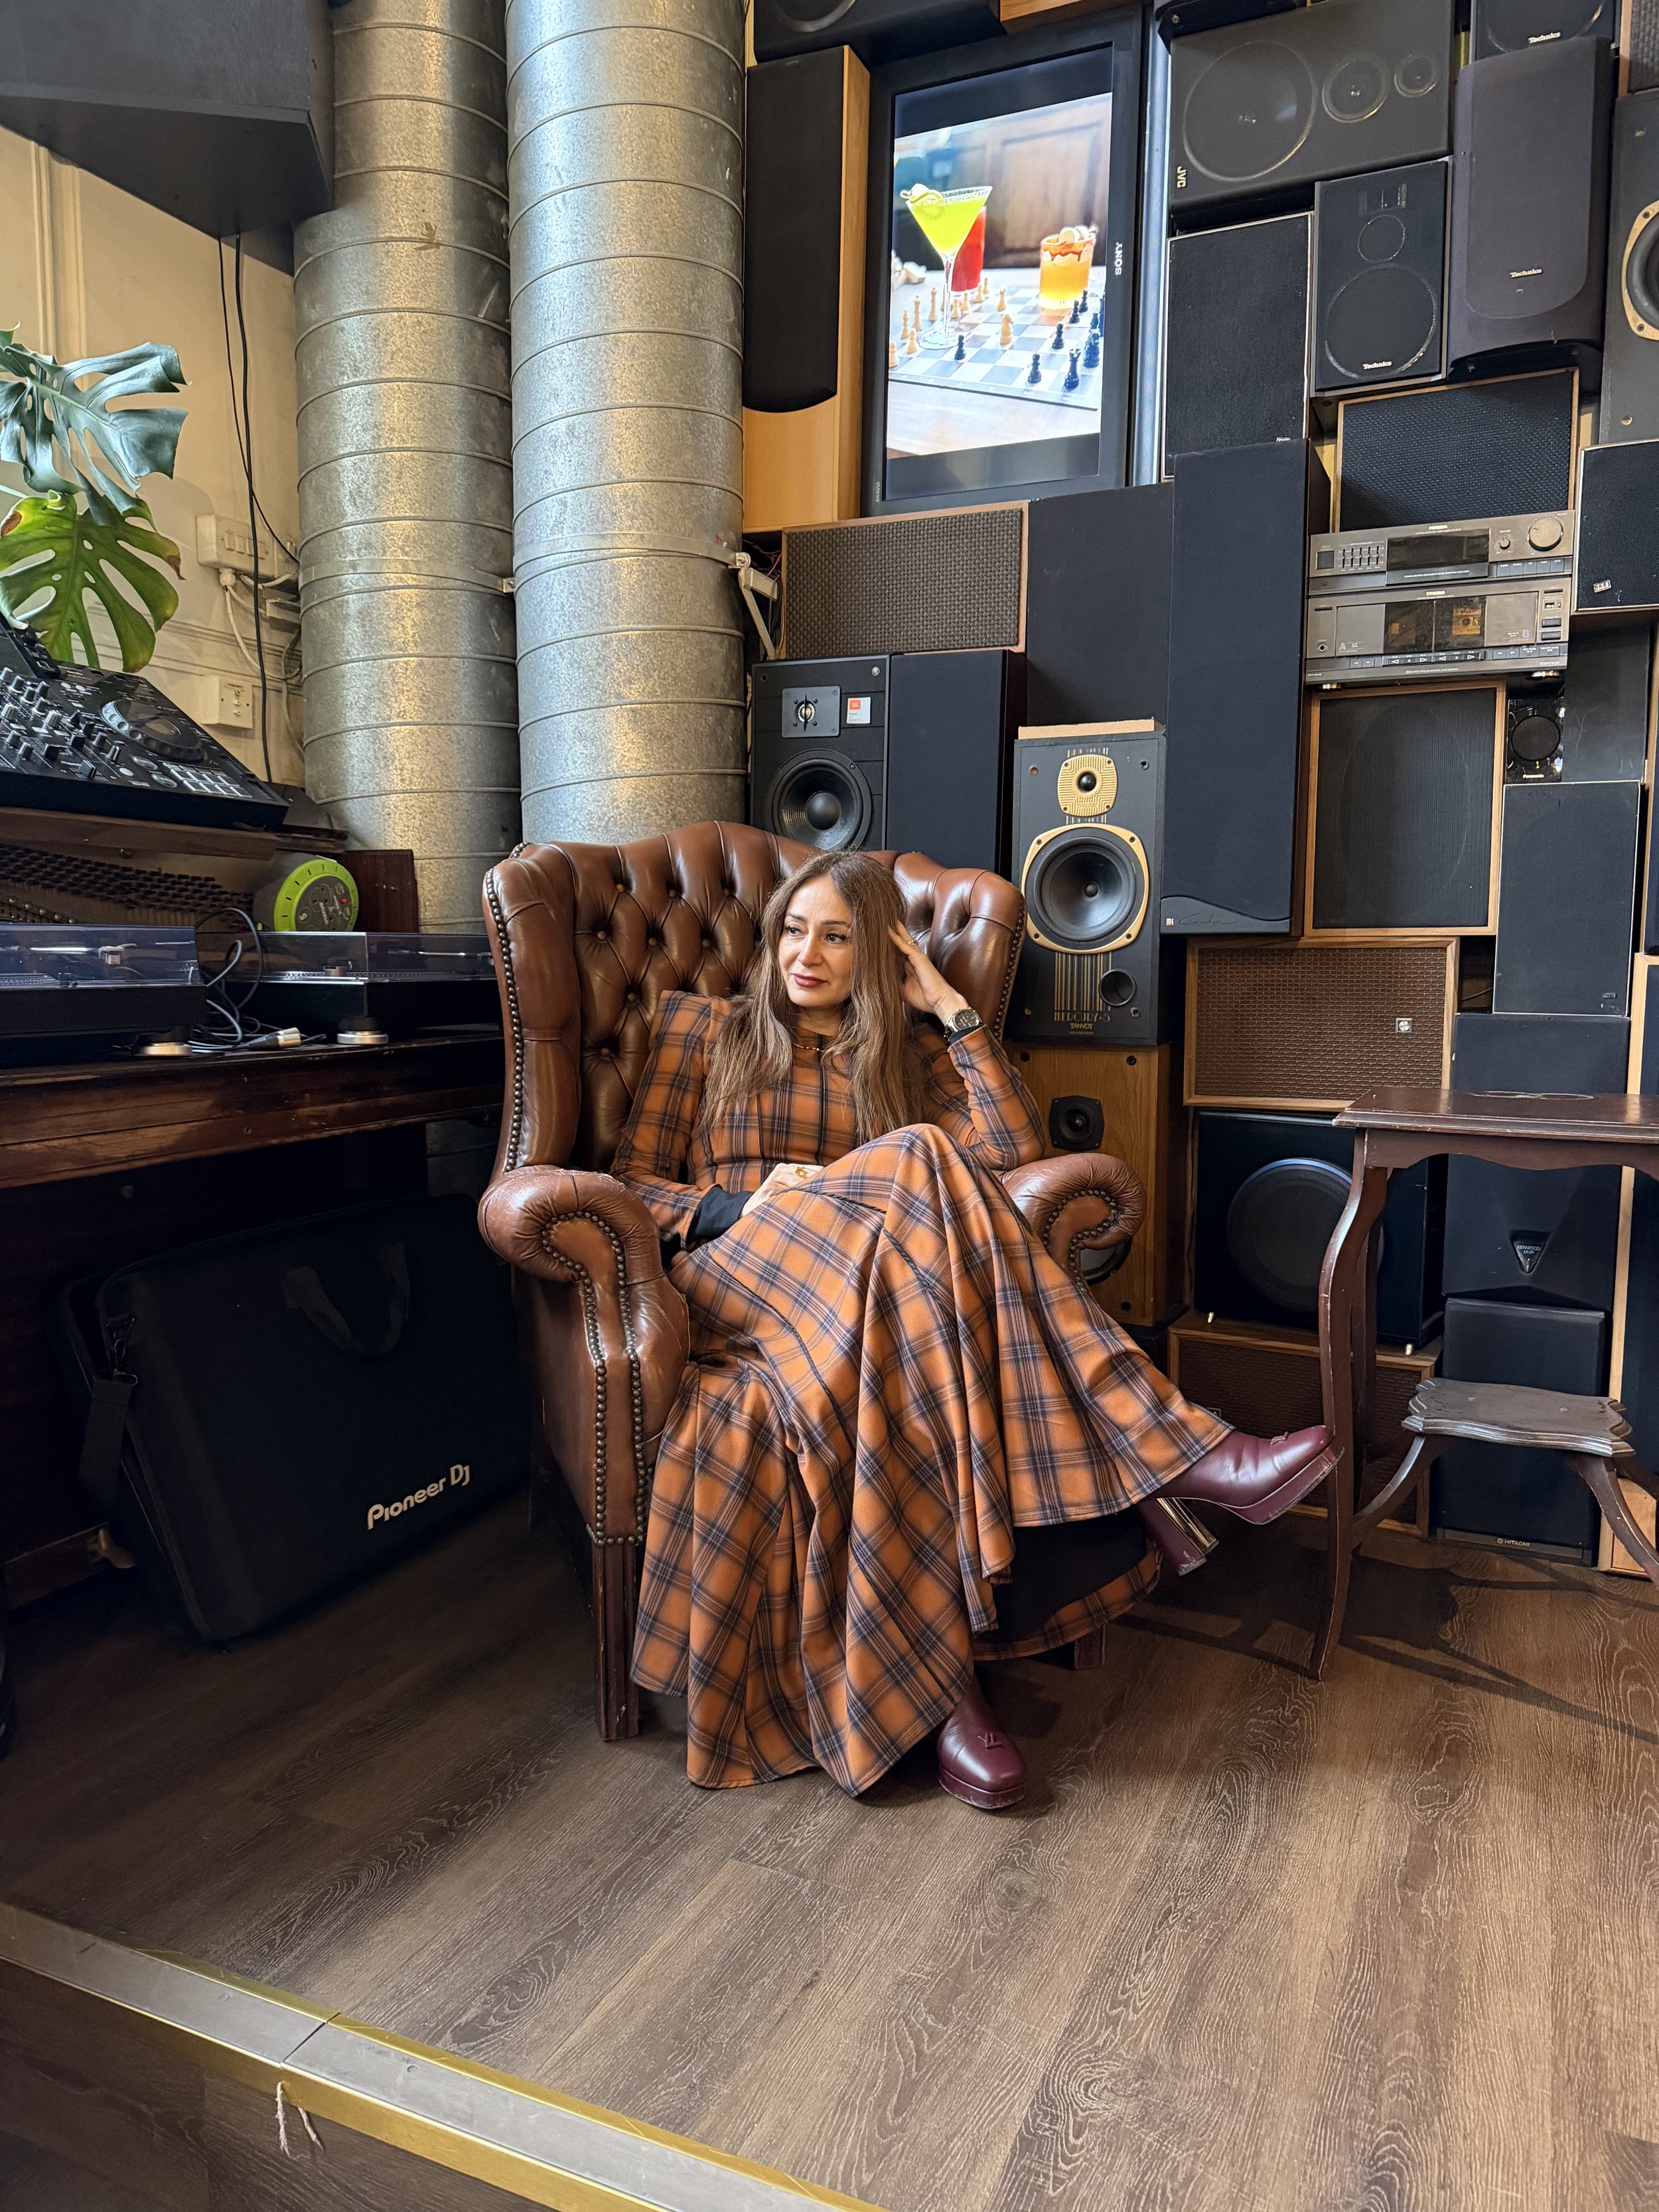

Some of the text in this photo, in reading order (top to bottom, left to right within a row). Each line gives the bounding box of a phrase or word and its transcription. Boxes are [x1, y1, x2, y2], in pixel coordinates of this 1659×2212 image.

[1528, 32, 1560, 44] Technics
[1177, 166, 1187, 188] JVC
[1510, 269, 1542, 277] Technics
[1362, 361, 1392, 370] Technics
[368, 1464, 470, 1530] Pioneer DJ
